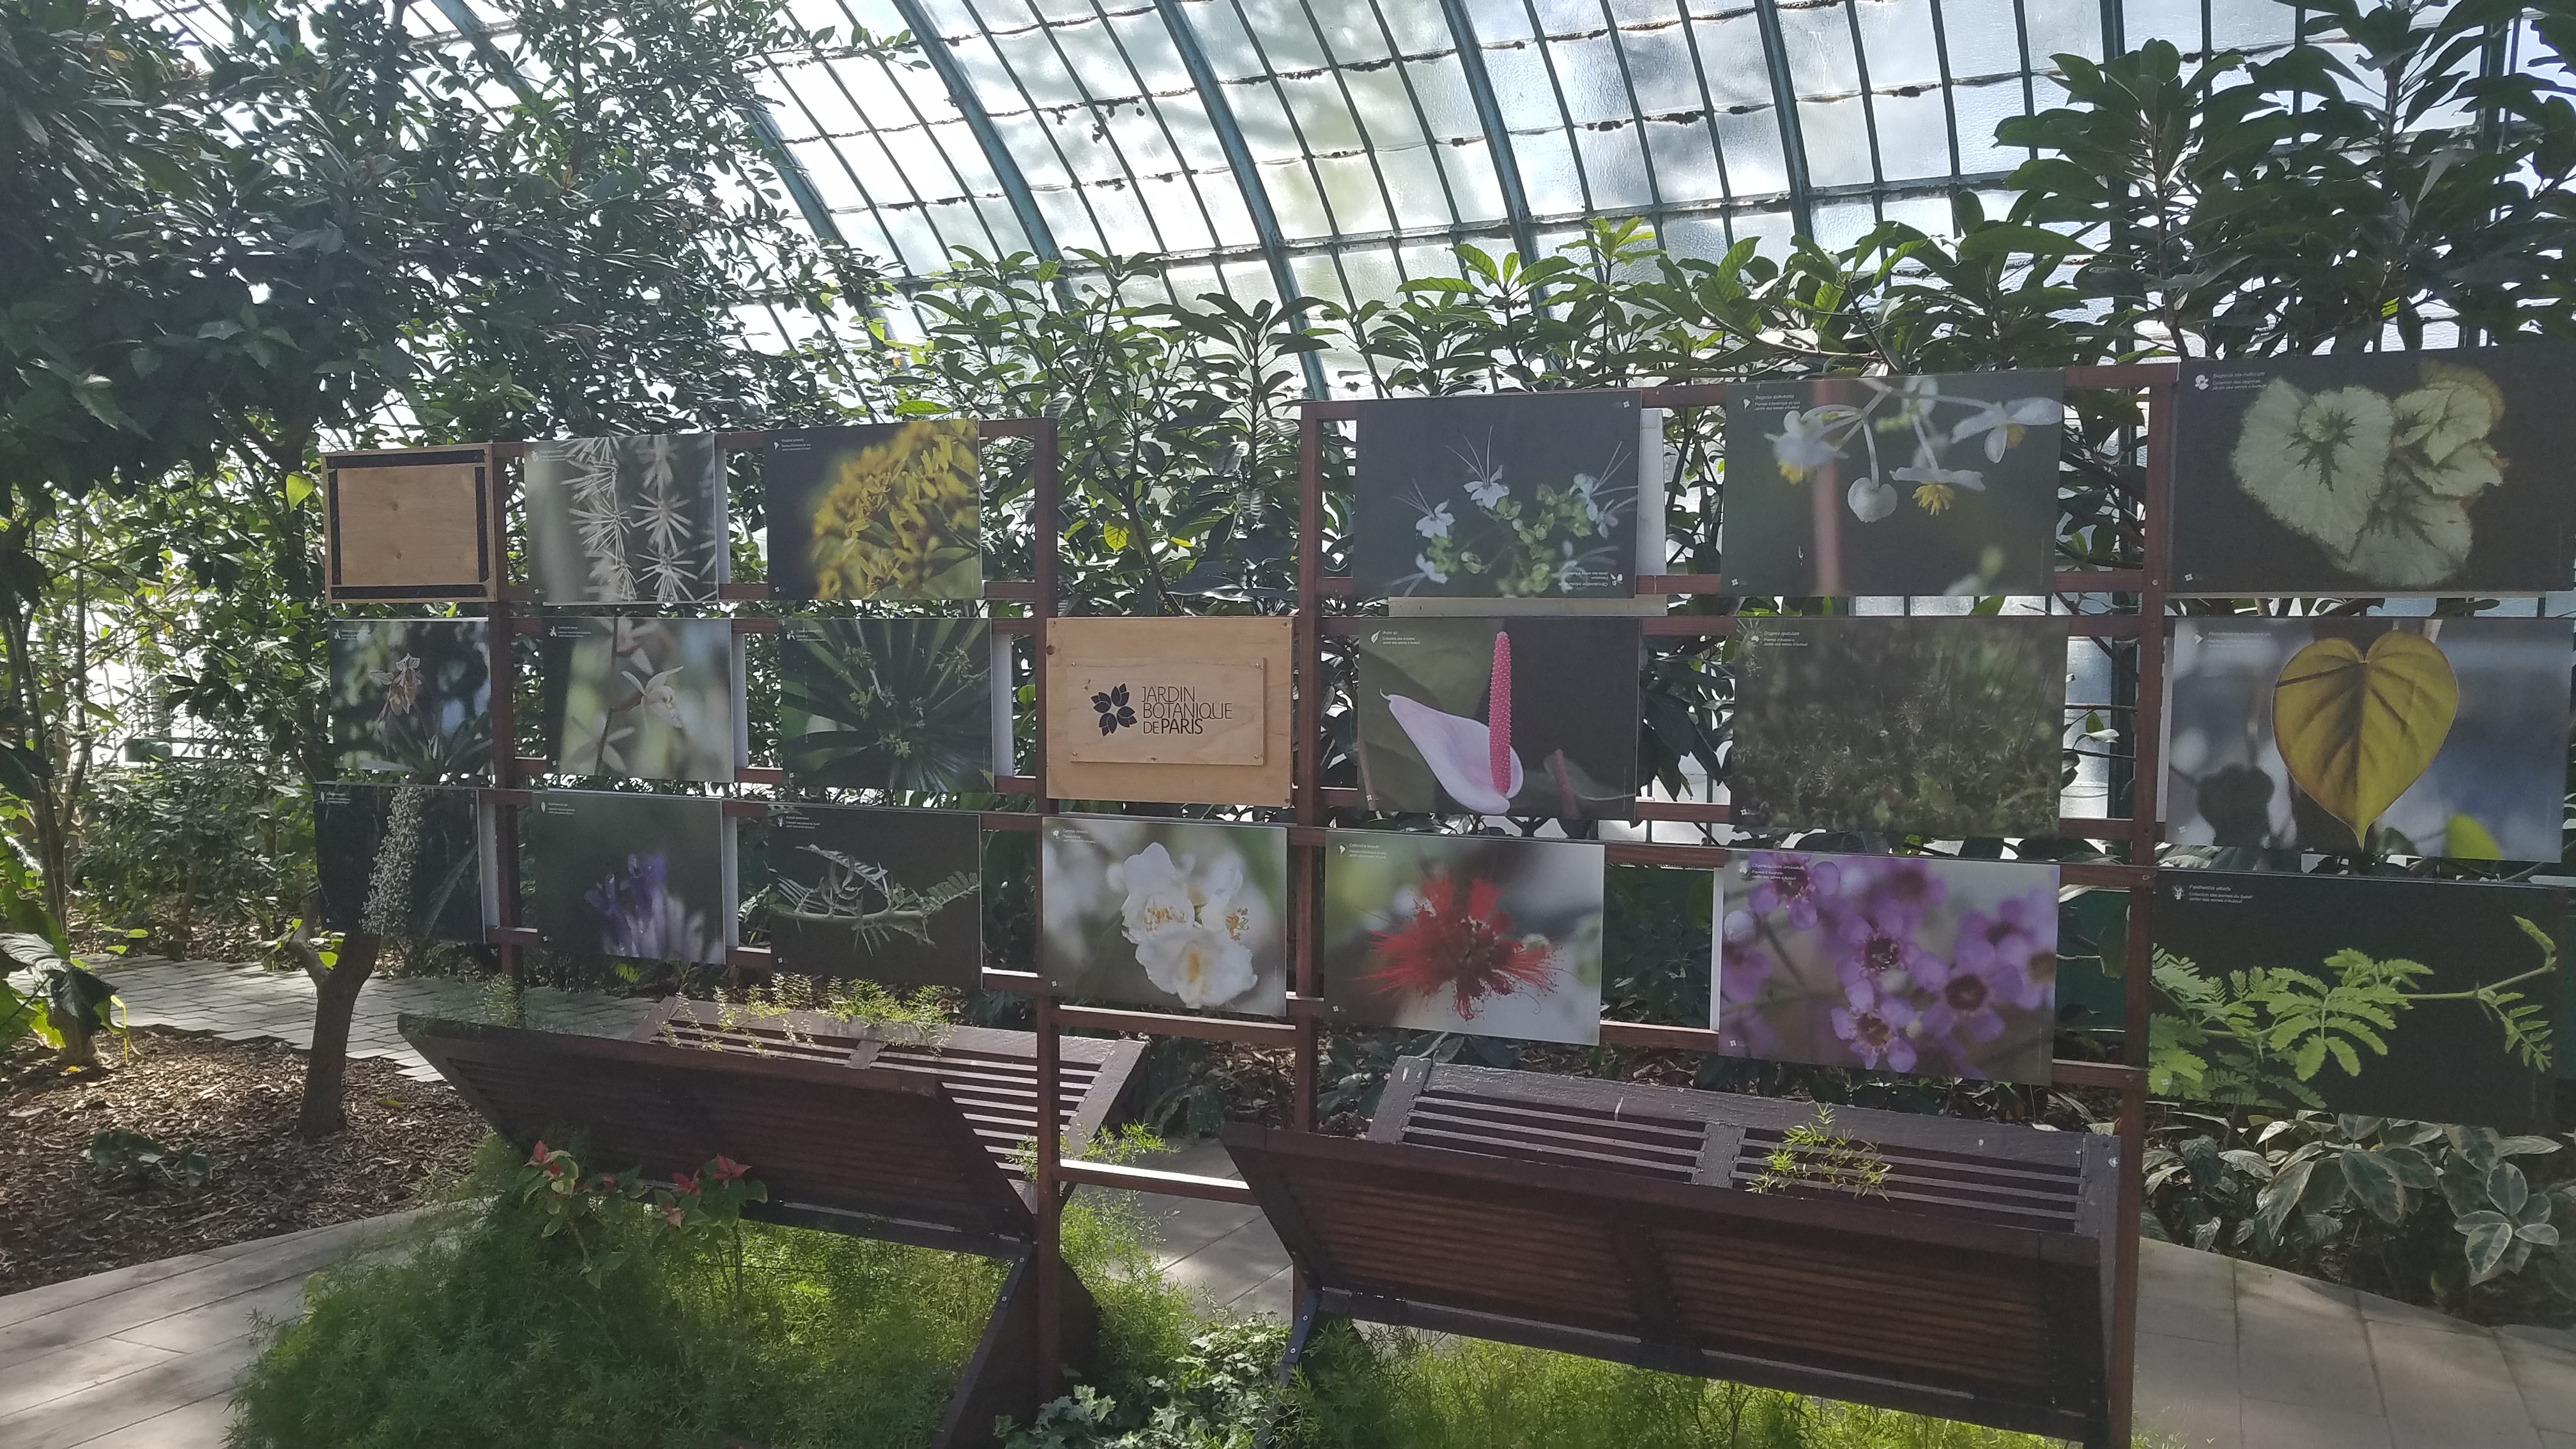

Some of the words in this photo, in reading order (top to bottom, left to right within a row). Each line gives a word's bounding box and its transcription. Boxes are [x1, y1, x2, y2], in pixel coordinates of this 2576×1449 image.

[1141, 686, 1195, 703] JARDIN
[1143, 702, 1233, 720] BOTANIQUE
[1161, 718, 1203, 735] PARIS
